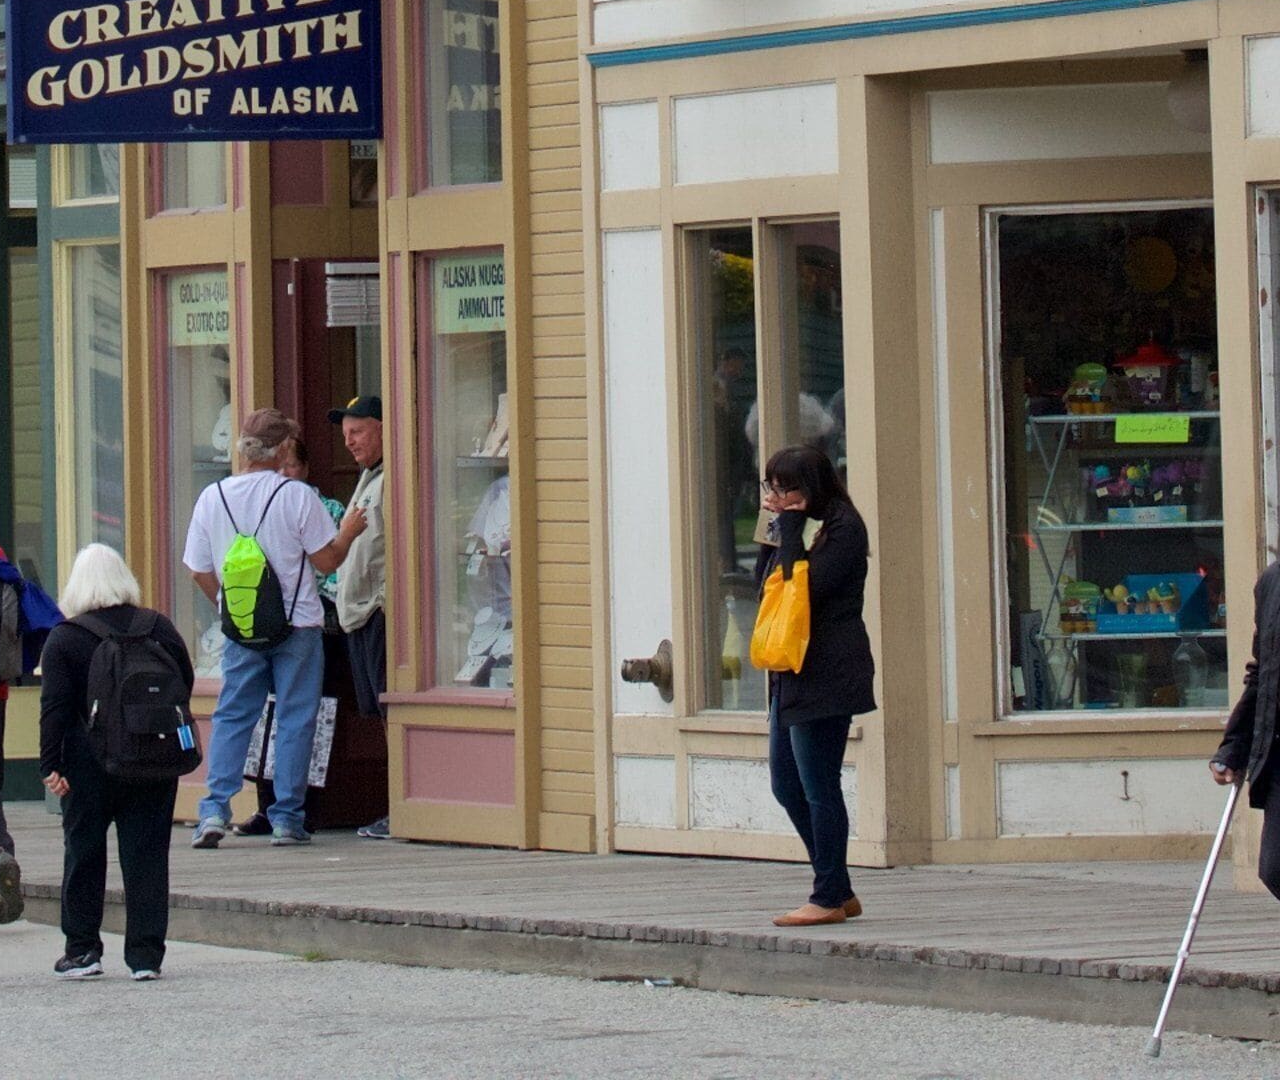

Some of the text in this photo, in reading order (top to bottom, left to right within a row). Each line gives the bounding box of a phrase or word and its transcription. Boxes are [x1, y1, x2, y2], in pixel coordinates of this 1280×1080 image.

[26, 9, 363, 108] GOLDSMITH
[172, 85, 360, 115] OF ALASKA
[442, 263, 506, 288] ALASKA NUGG
[458, 296, 505, 320] AMMOLITE
[186, 311, 214, 333] EXOTIC
